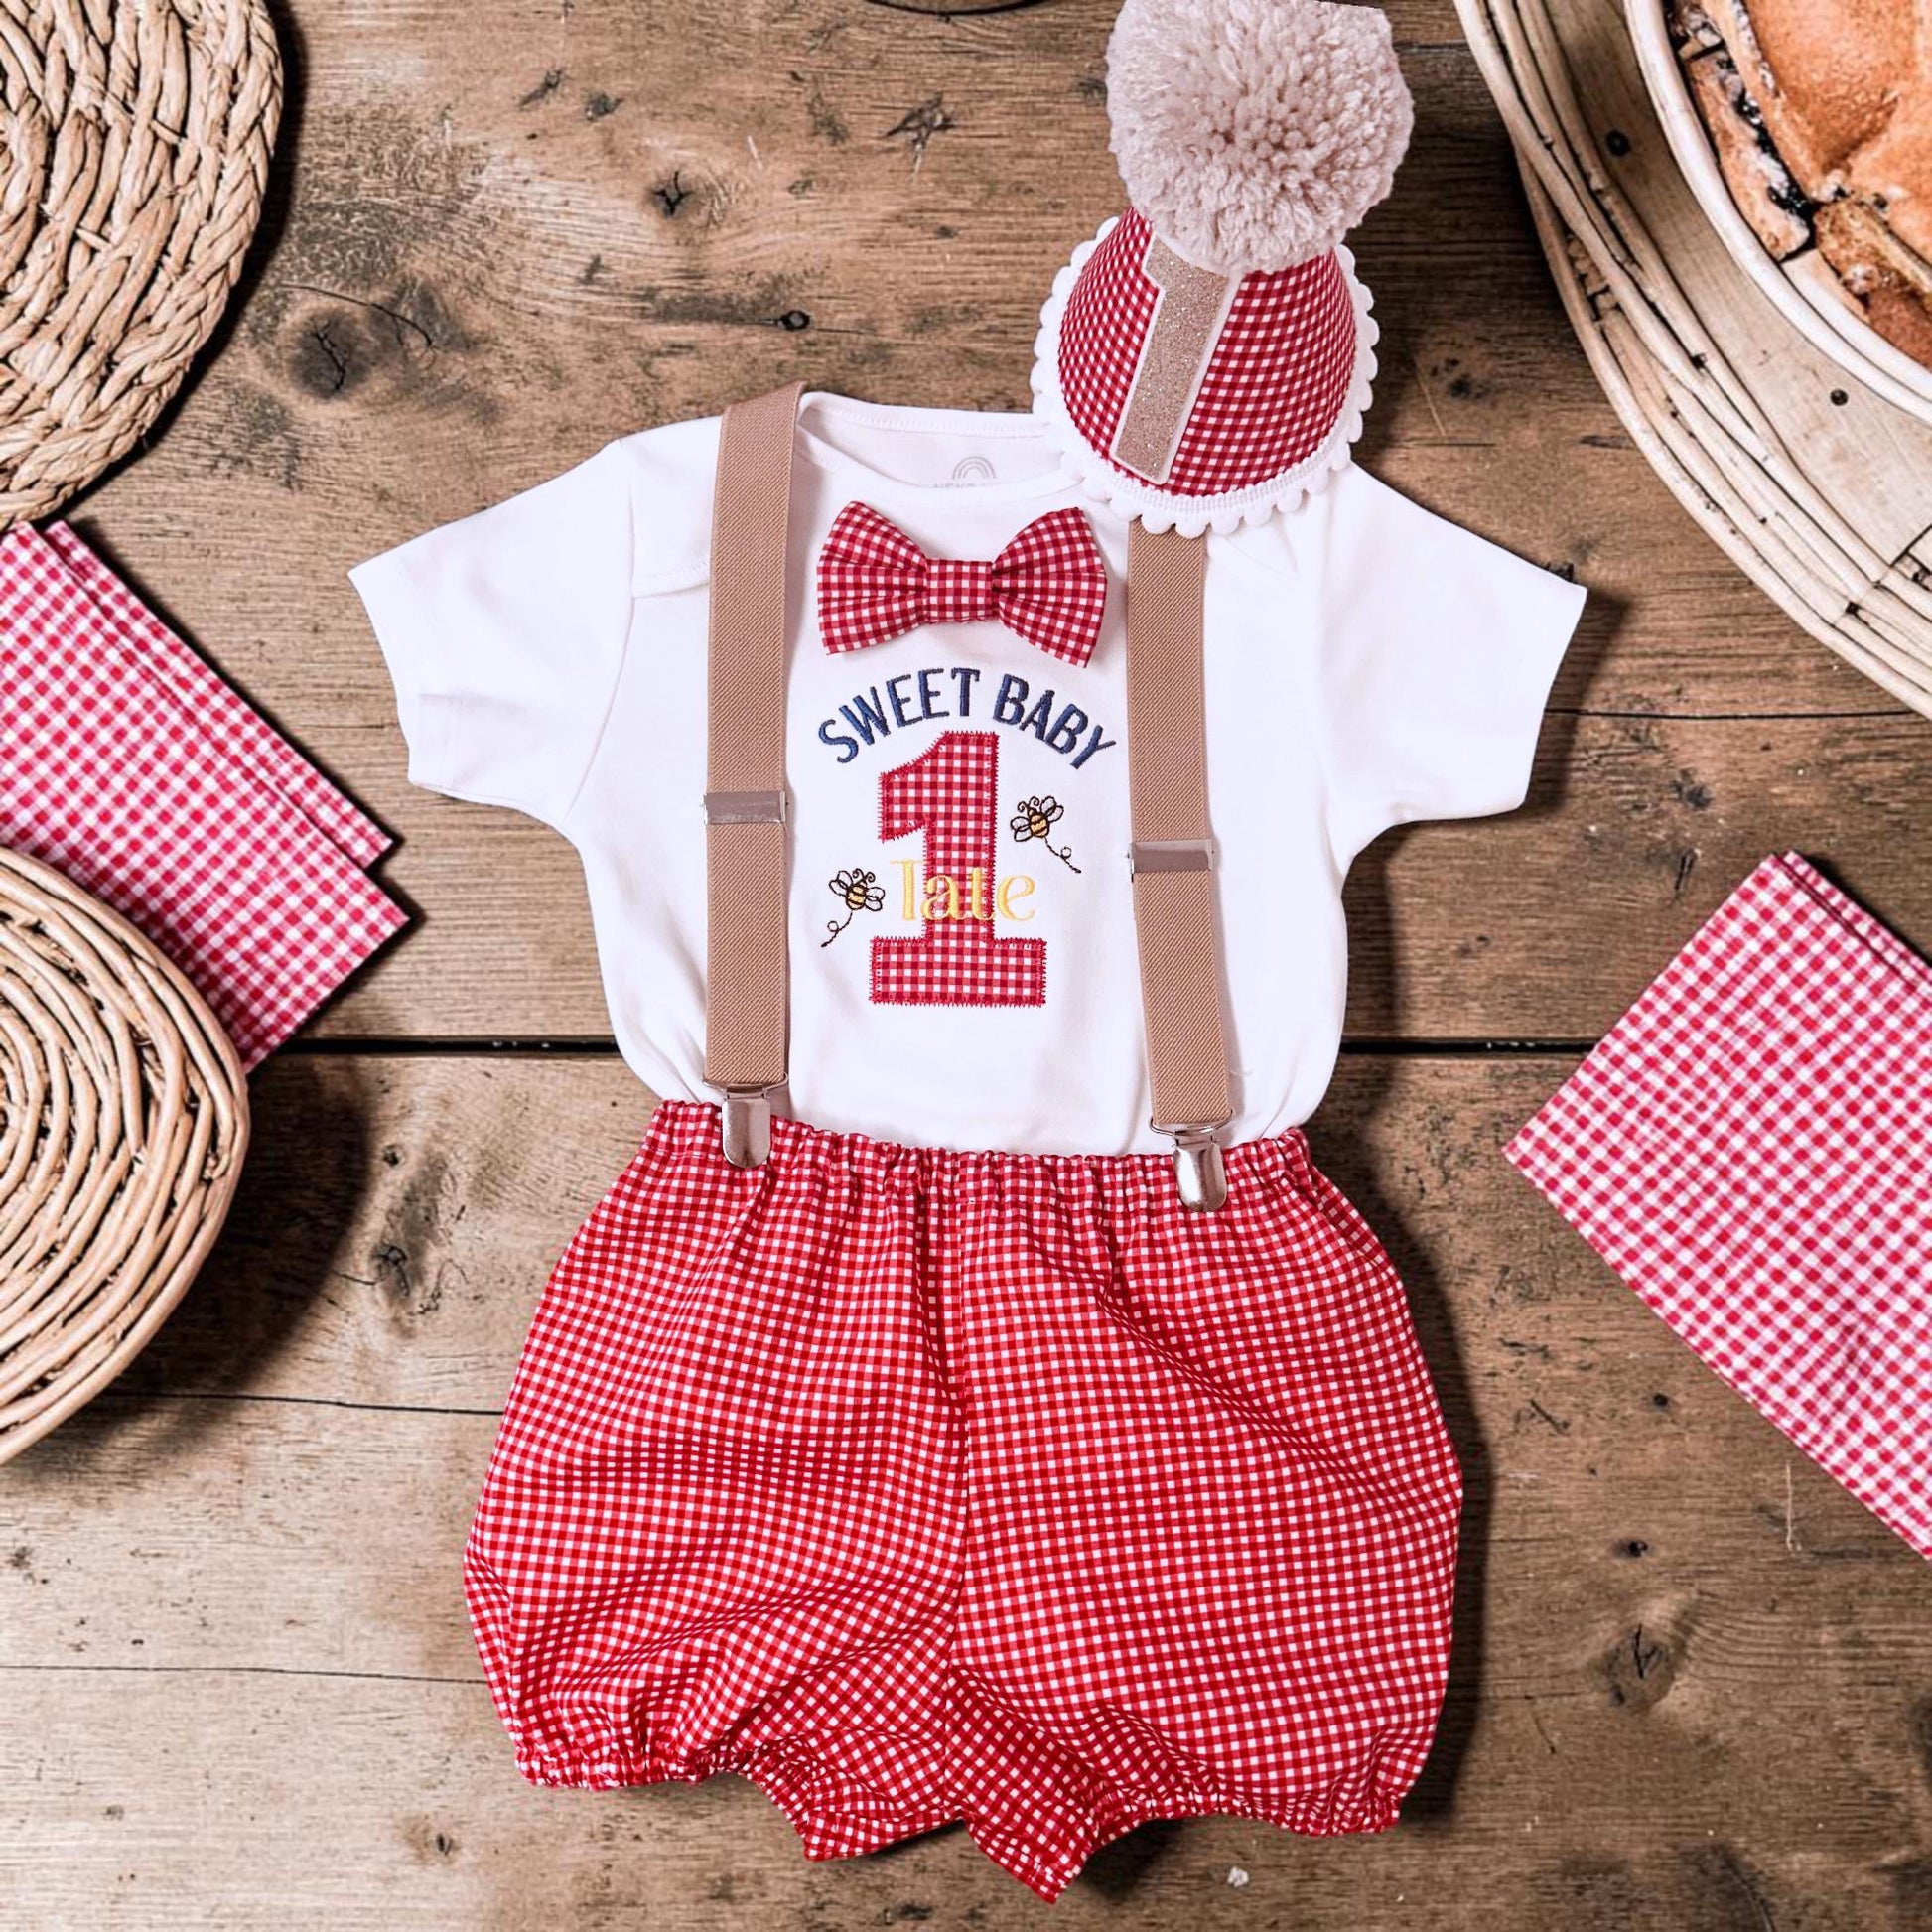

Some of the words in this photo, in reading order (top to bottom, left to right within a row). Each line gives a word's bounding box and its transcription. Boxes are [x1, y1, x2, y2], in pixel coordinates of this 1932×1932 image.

[818, 667, 981, 764] SWEET
[993, 673, 1117, 770] BABY
[869, 731, 1047, 1007] 1
[891, 858, 1036, 921] Tate
